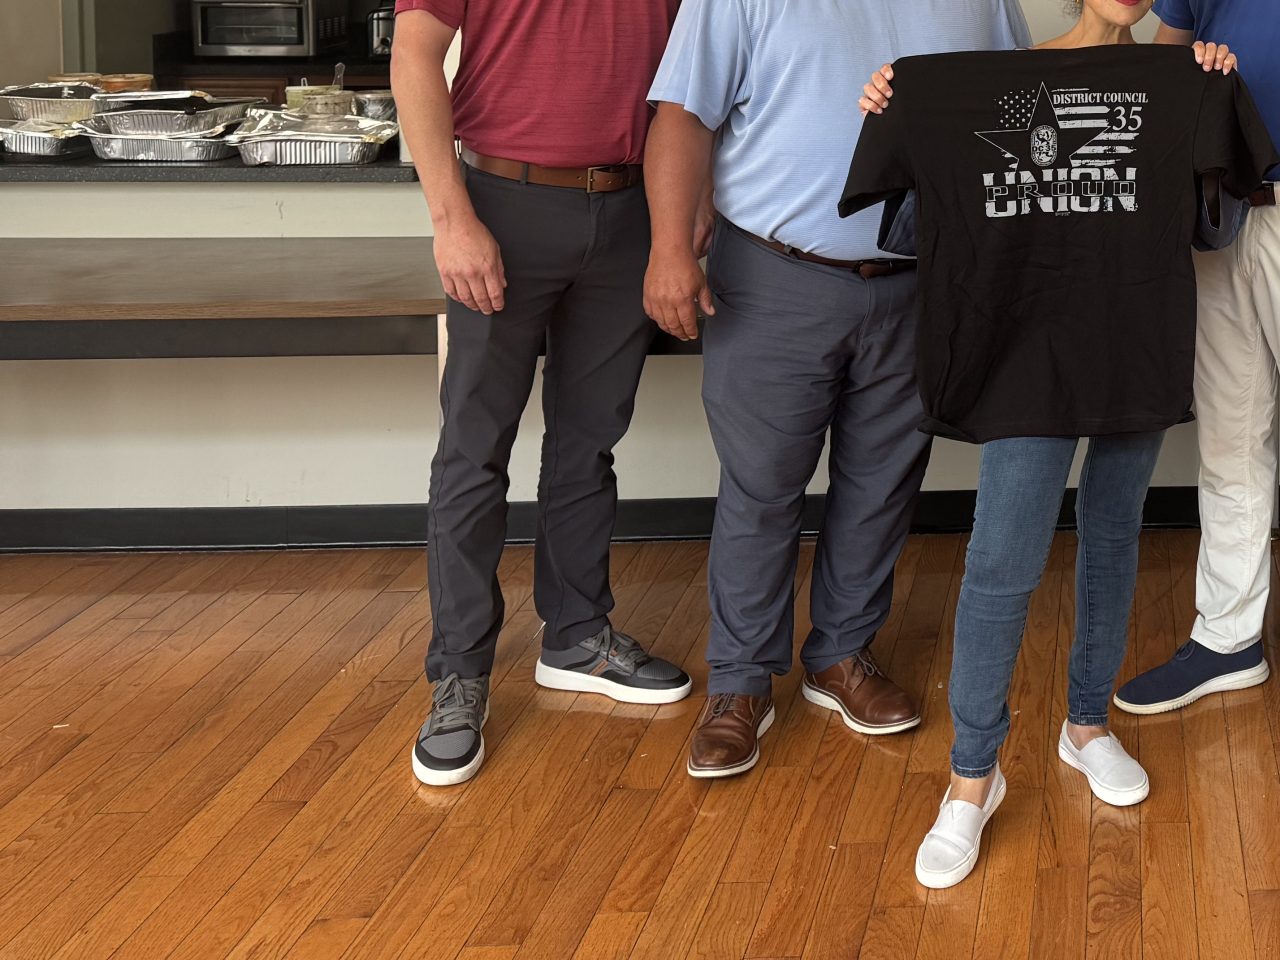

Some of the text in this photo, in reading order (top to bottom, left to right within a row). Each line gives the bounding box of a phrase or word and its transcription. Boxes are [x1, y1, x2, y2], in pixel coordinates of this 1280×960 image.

[1053, 92, 1149, 105] DISTRICT COUNCIL
[1112, 106, 1142, 131] 35
[983, 167, 1139, 218] UNION
[986, 180, 1136, 202] PROUD
